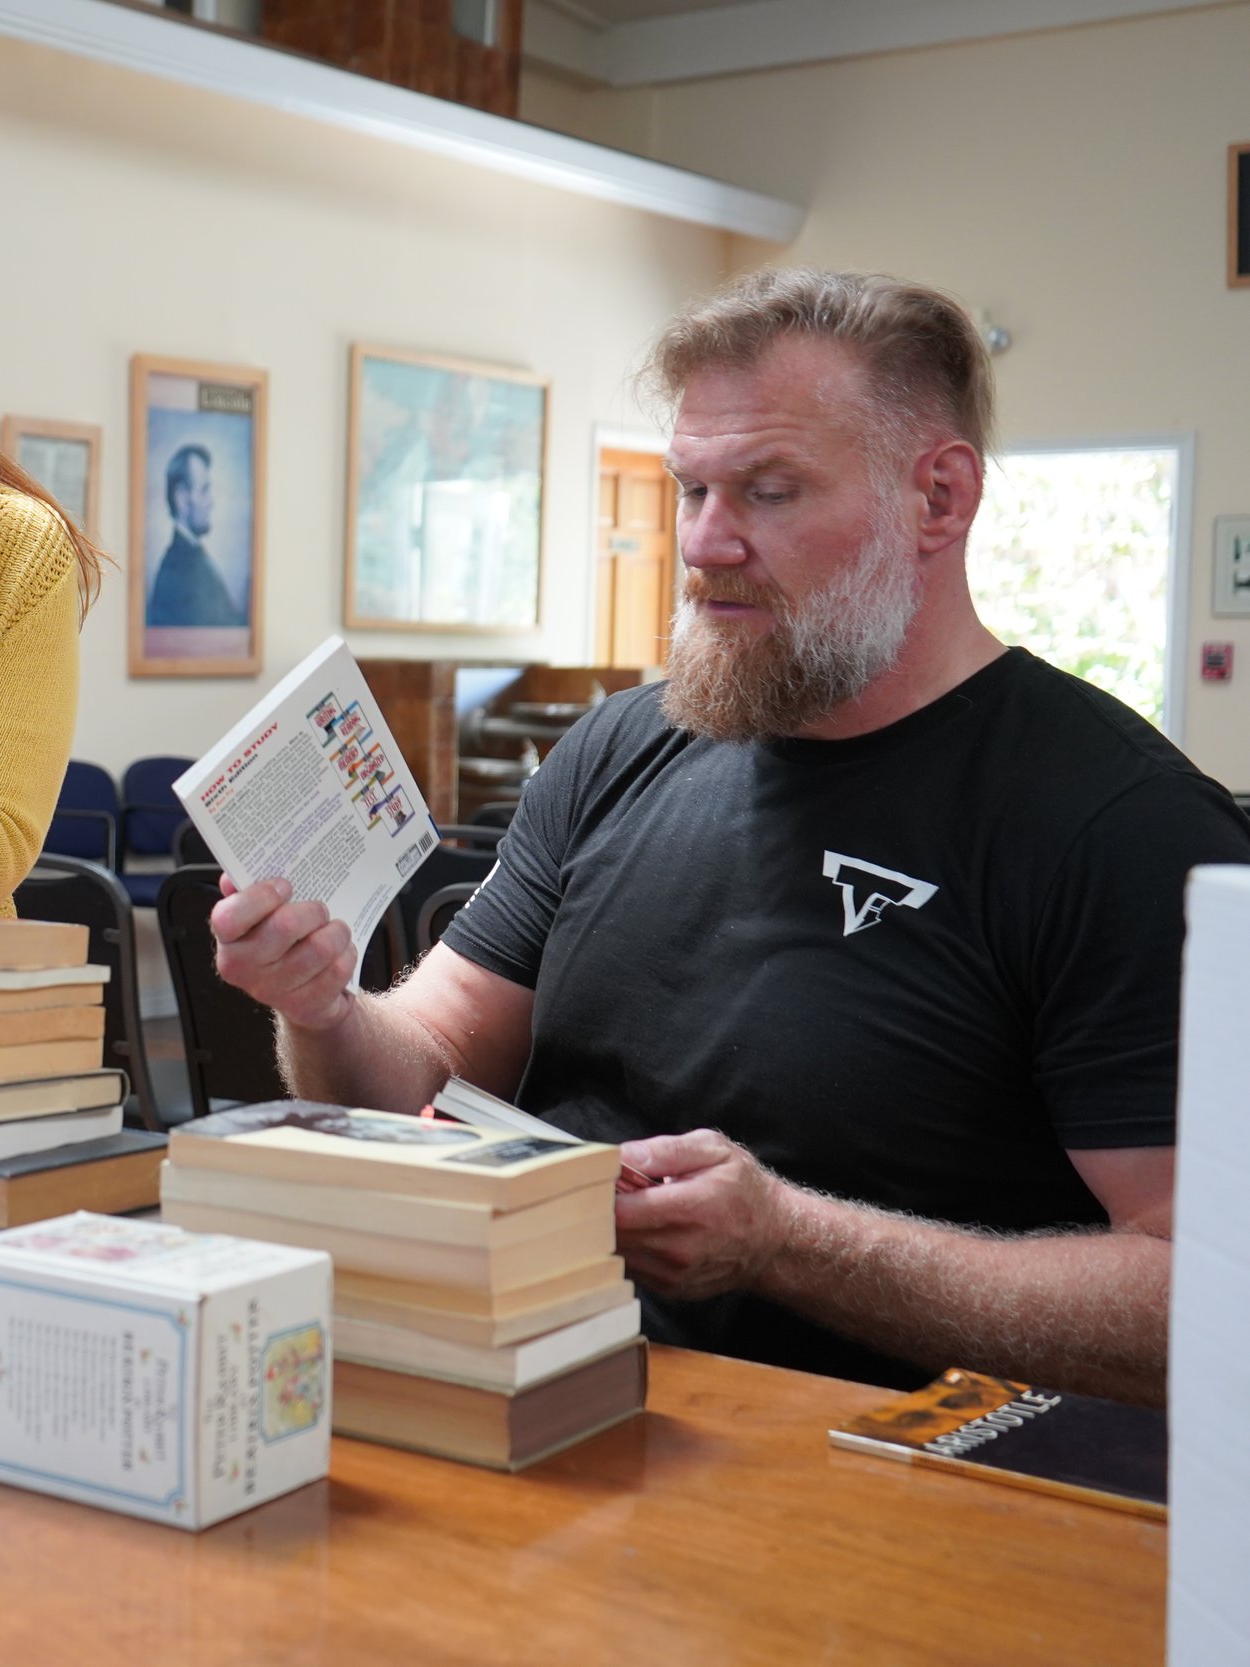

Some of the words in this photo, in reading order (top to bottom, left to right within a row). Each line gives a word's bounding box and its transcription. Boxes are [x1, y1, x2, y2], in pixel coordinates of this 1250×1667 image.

[200, 775, 226, 801] HOW
[227, 758, 242, 774] TO
[243, 721, 278, 758] STUDY
[228, 753, 258, 783] Edition
[922, 1389, 1063, 1458] ARISTOTLE
